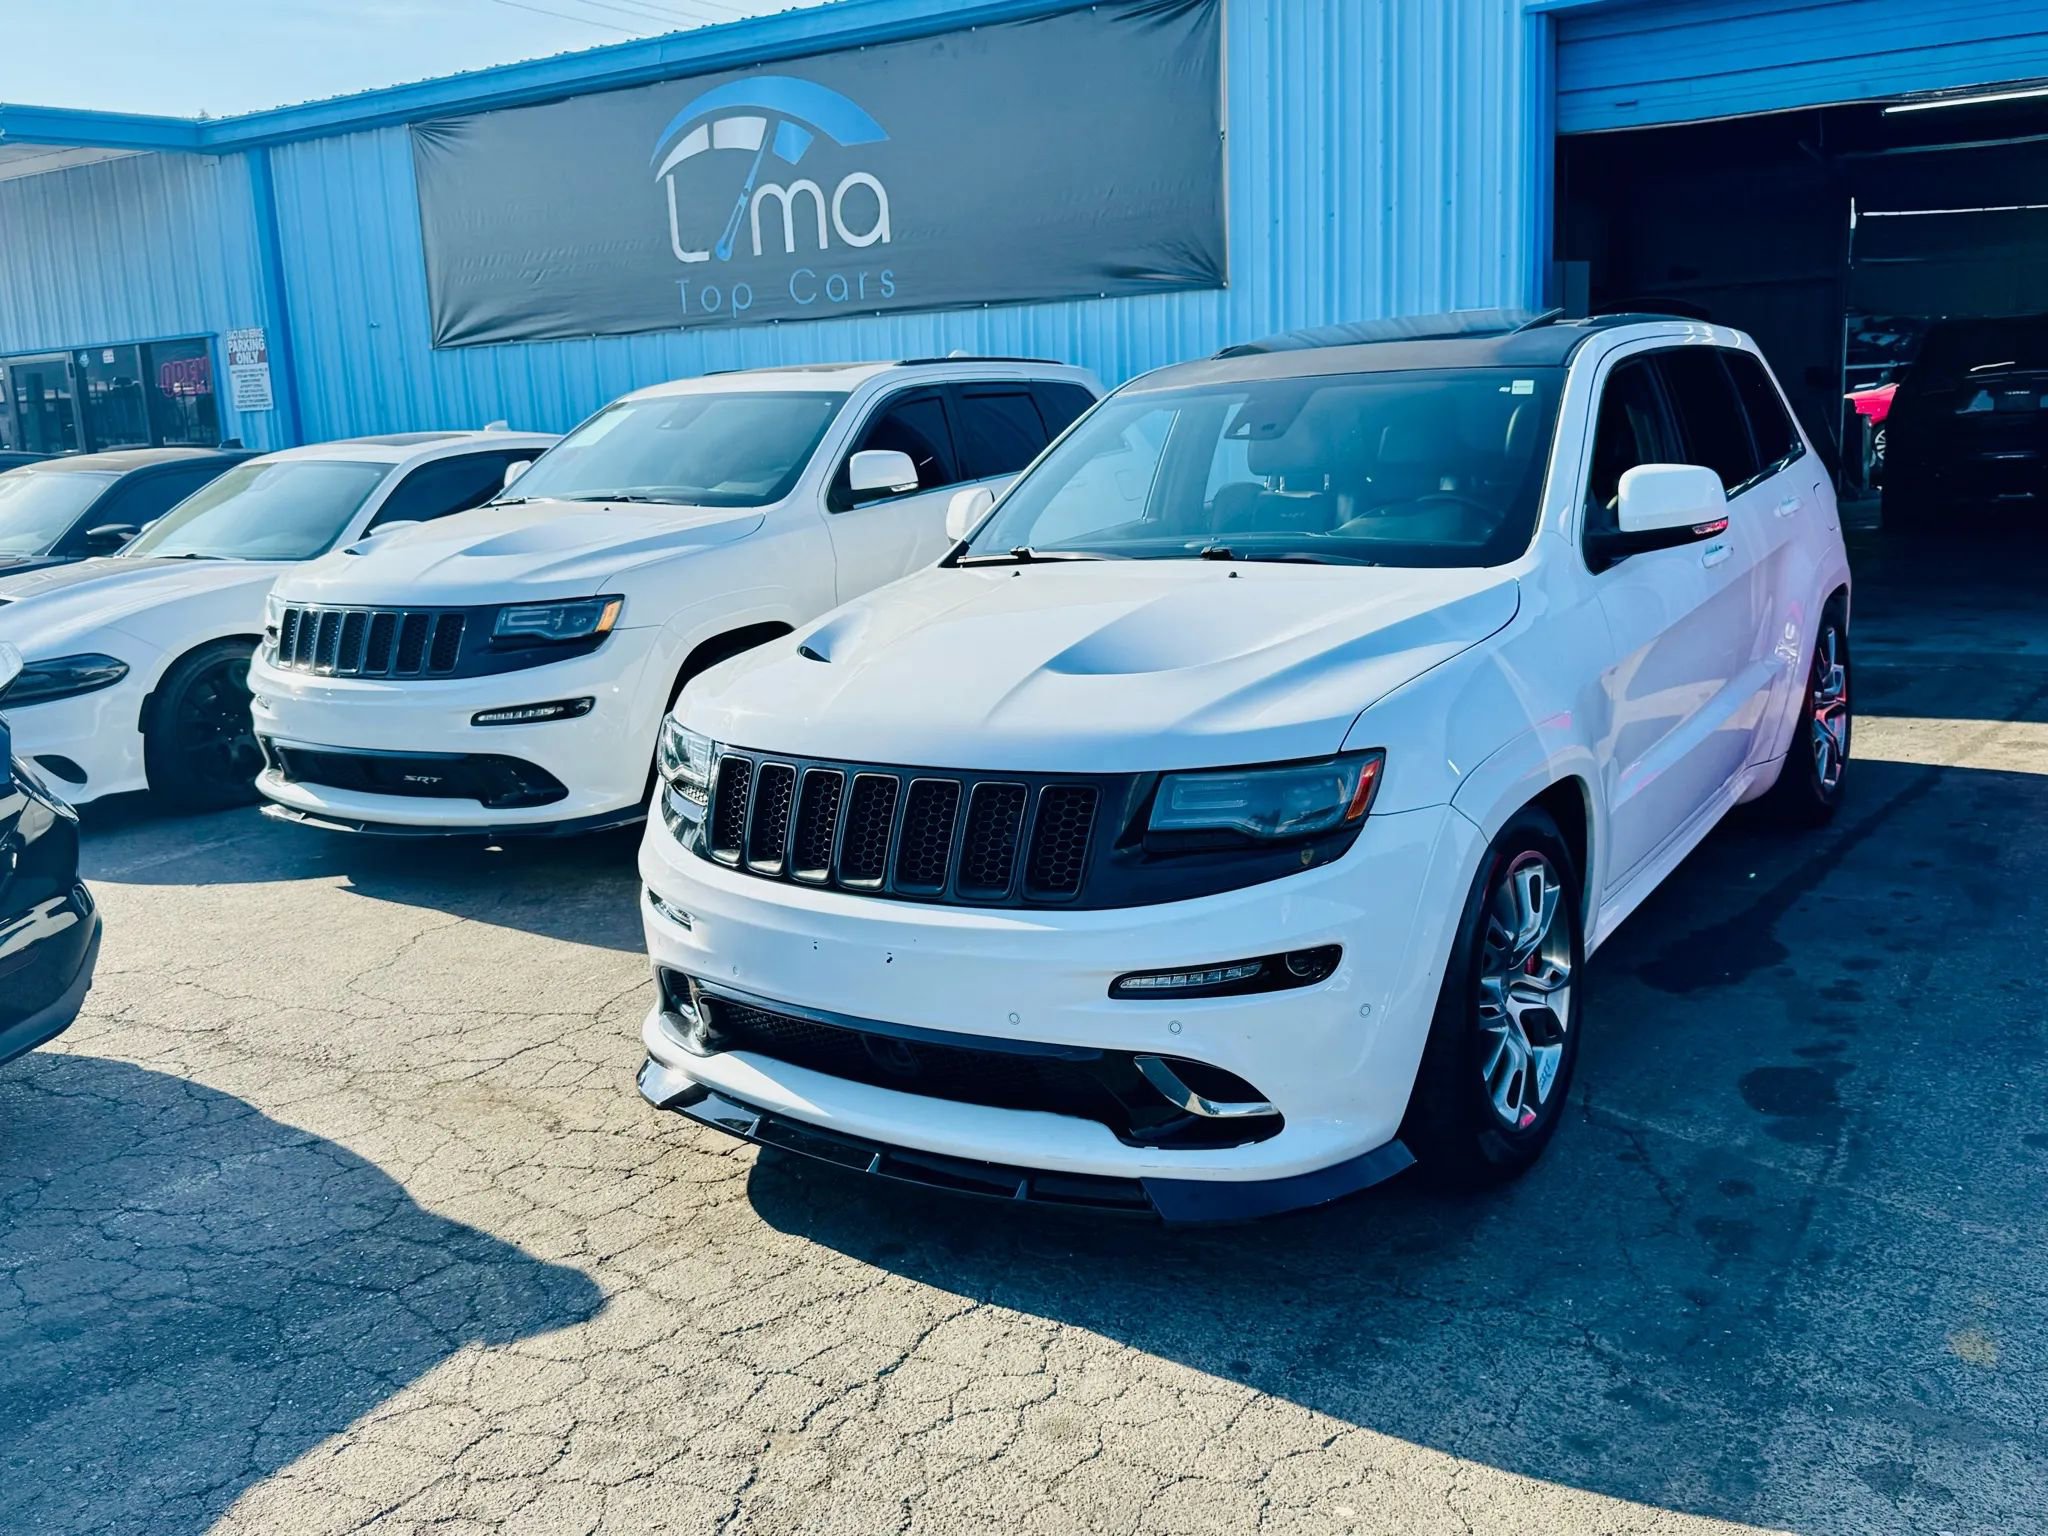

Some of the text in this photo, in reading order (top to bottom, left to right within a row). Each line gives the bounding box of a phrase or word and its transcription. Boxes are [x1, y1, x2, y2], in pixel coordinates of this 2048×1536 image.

[675, 268, 896, 318] Top Cars
[227, 338, 265, 353] PARKING
[236, 350, 259, 364] ONLY
[403, 775, 443, 784] SRT
